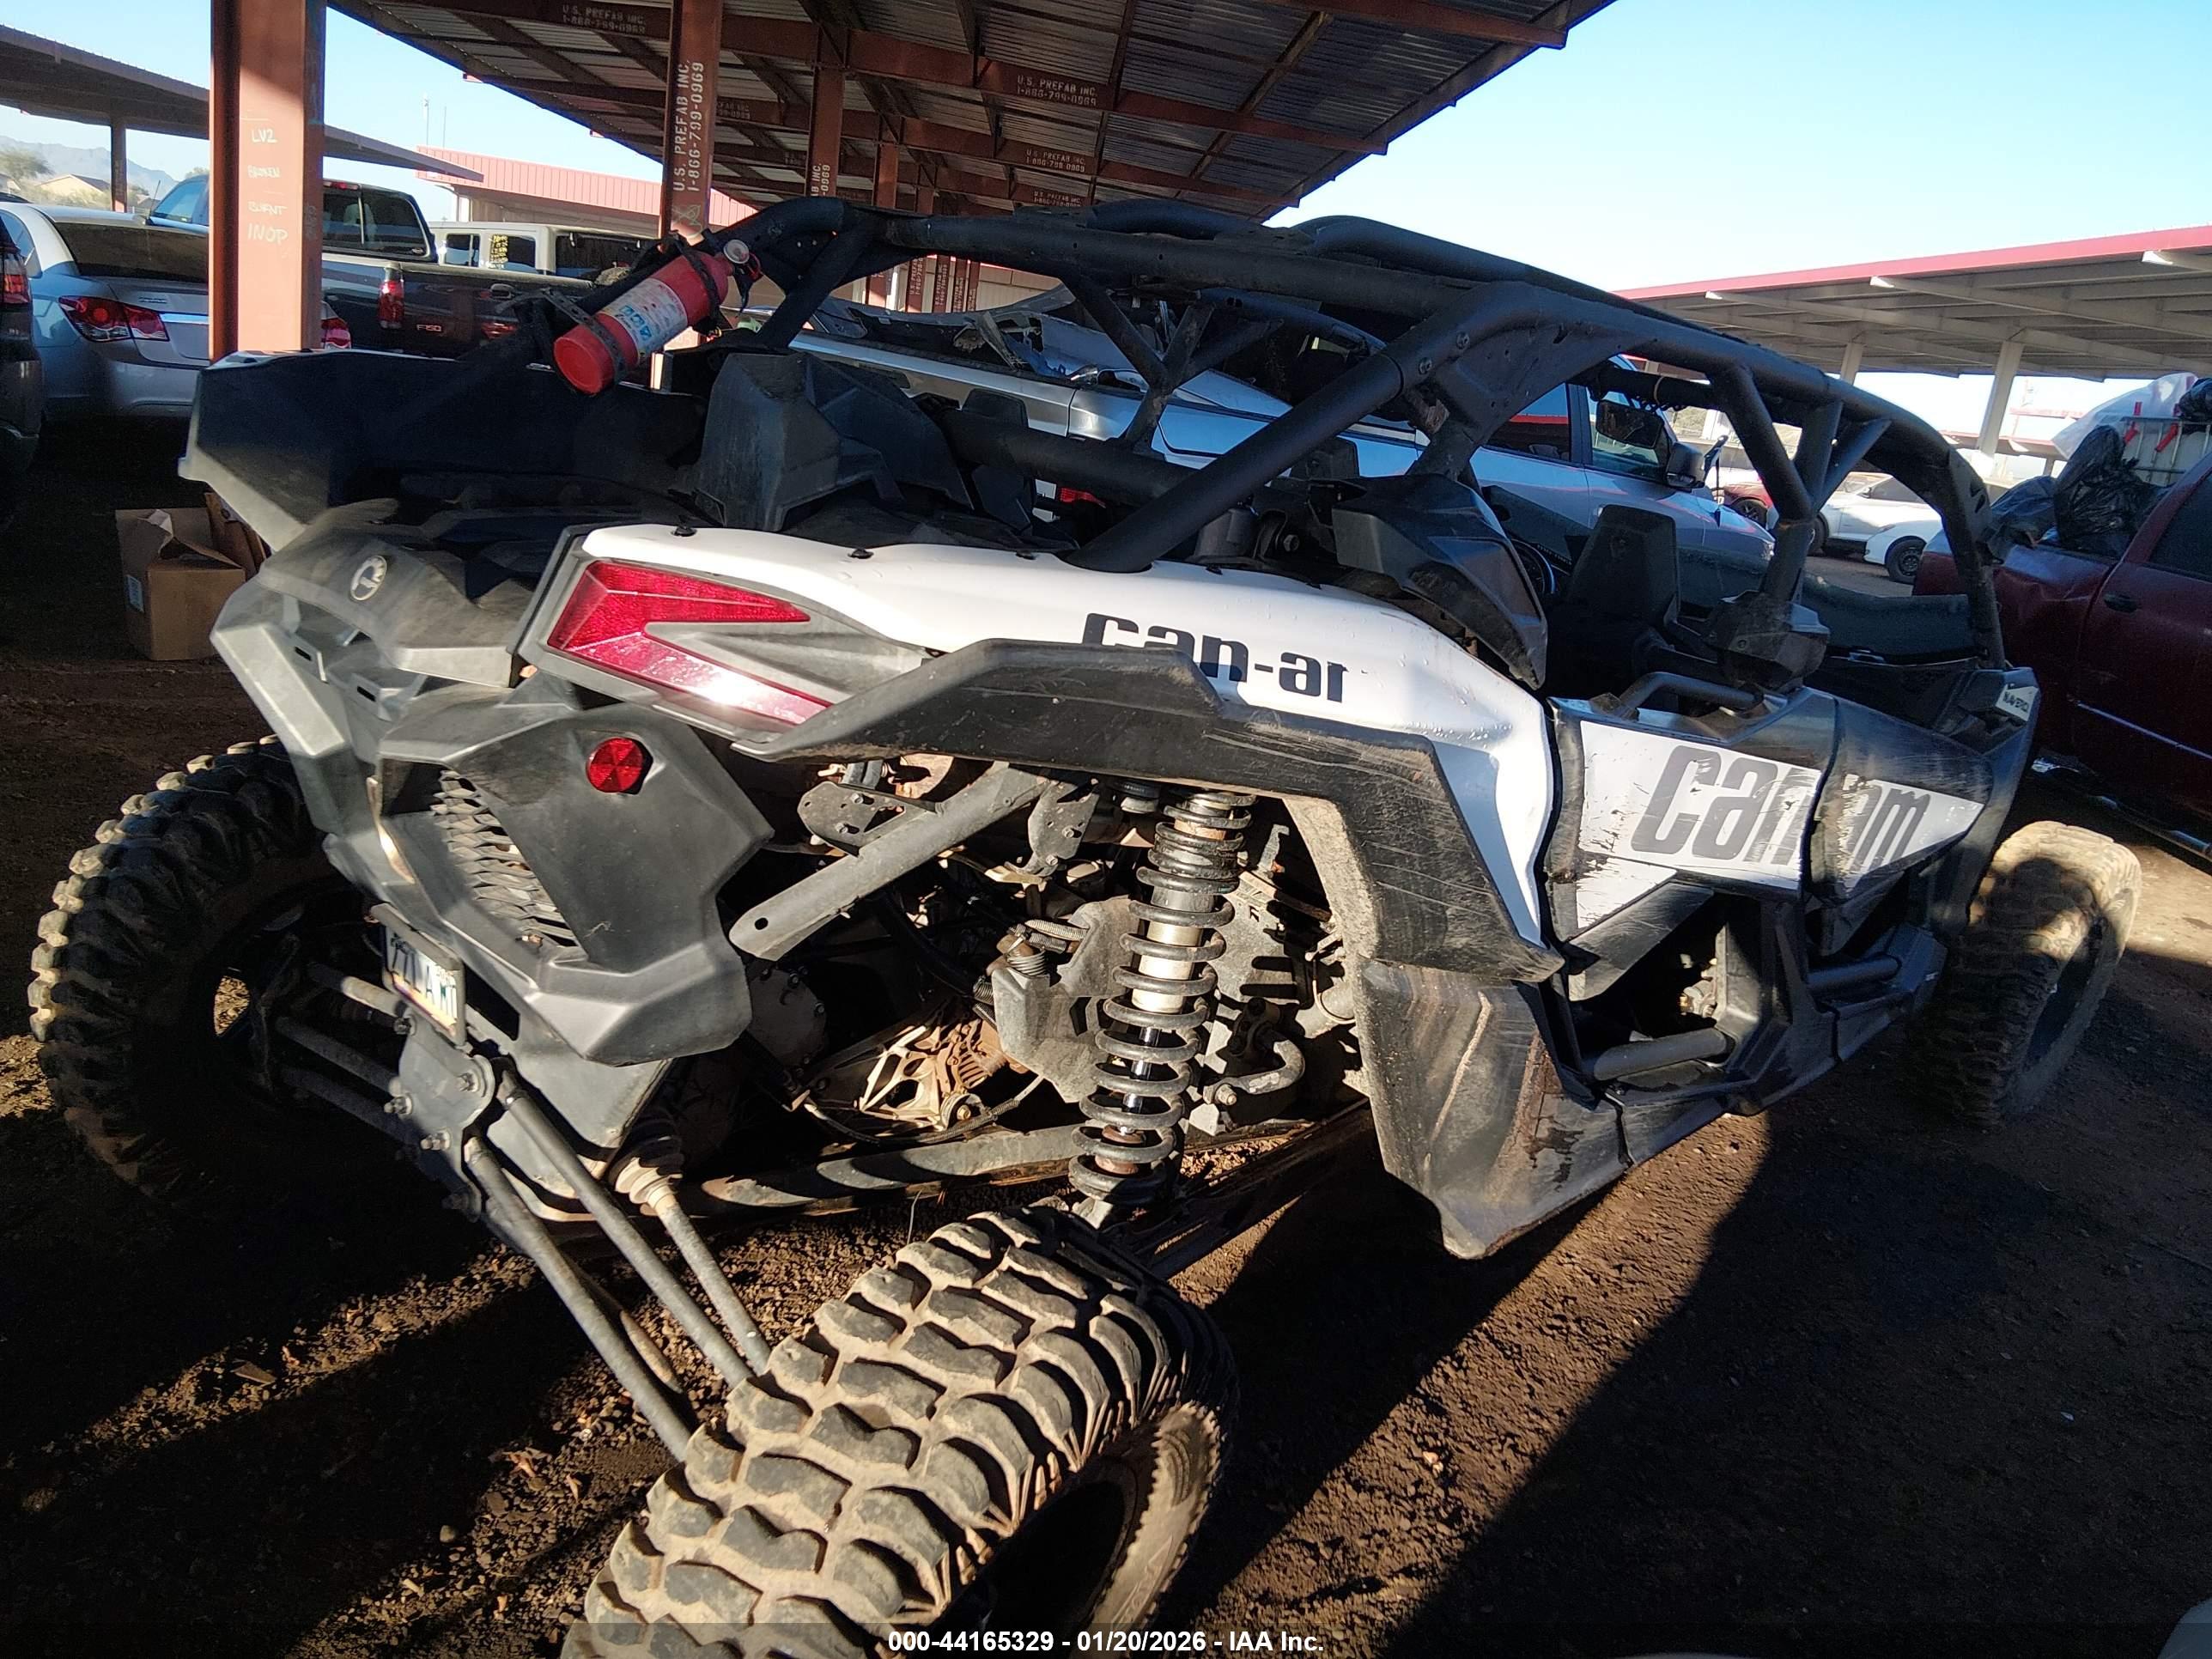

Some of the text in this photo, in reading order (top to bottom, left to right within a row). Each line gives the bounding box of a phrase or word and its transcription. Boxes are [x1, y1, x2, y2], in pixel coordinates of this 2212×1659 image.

[1039, 78, 1077, 93] PREFAB
[674, 96, 688, 155] PREFAB
[688, 62, 704, 191] 1-866-799-0969
[247, 222, 289, 246] INOP
